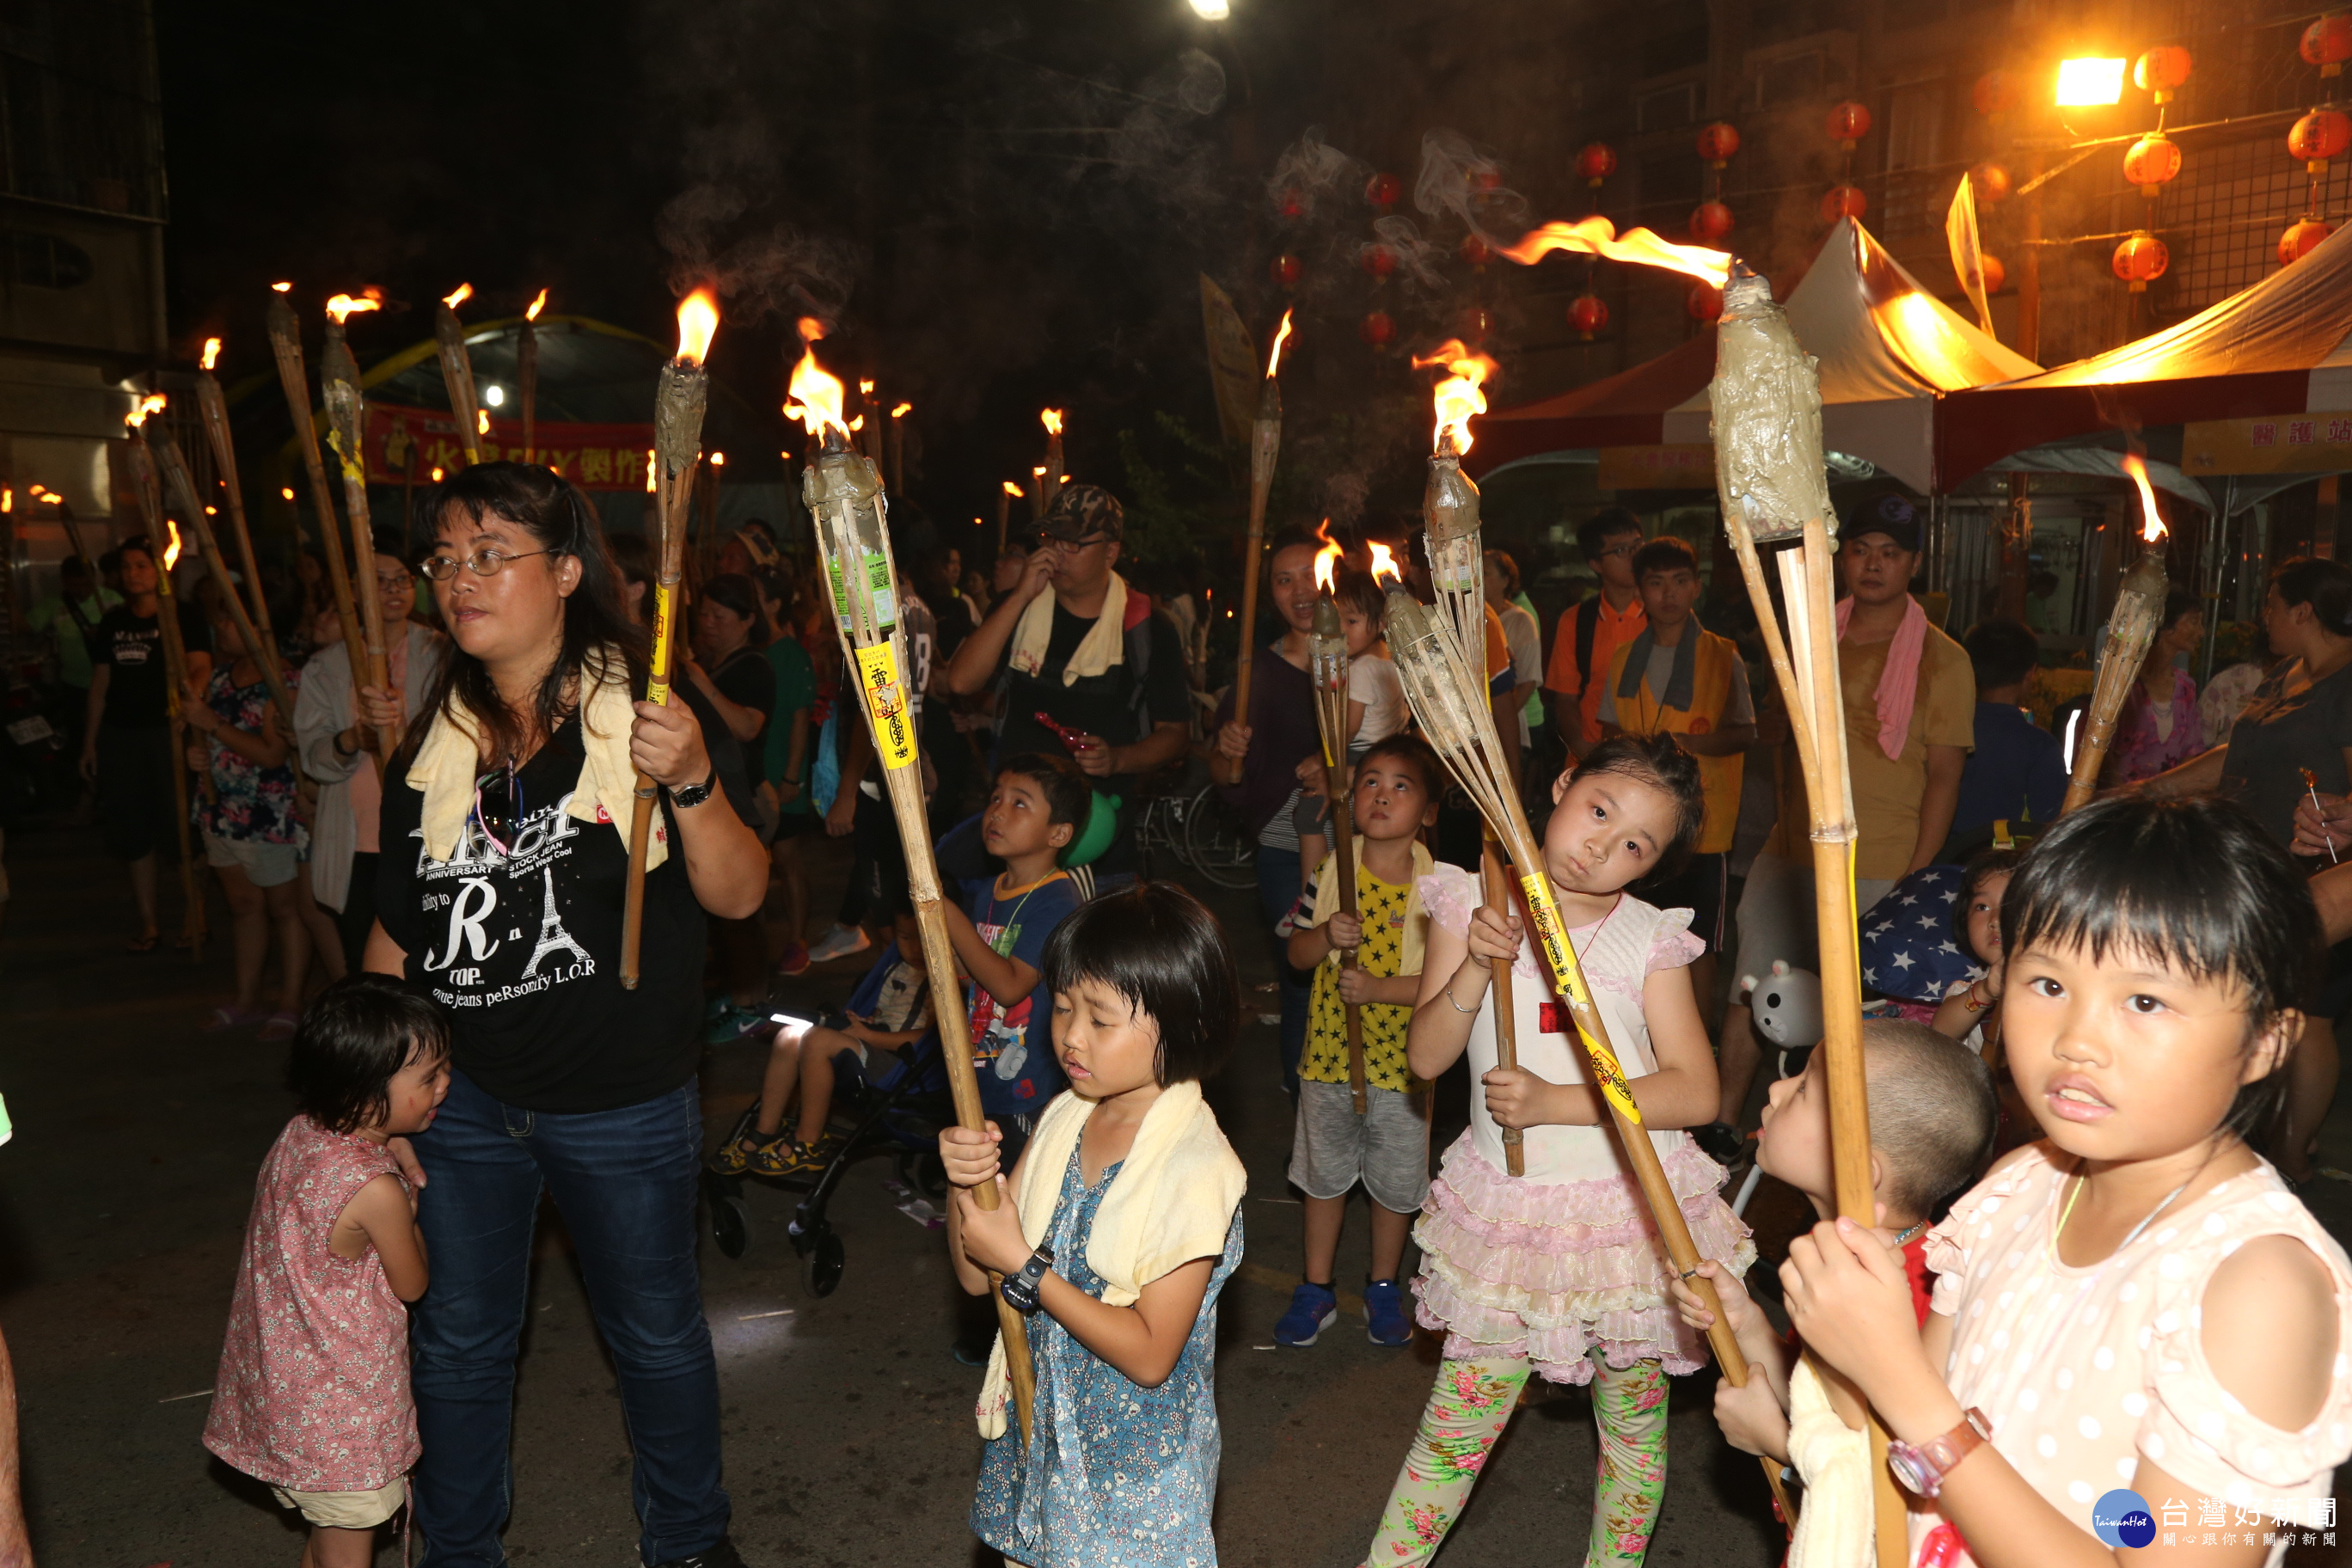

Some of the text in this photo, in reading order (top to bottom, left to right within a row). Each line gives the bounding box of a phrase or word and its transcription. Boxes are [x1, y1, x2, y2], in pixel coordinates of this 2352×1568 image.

[2251, 420, 2352, 447] 醫護站
[509, 841, 563, 872] STOCK JEAN
[535, 854, 554, 868] Wear
[554, 847, 573, 859] Cool
[452, 989, 482, 1009] jeans
